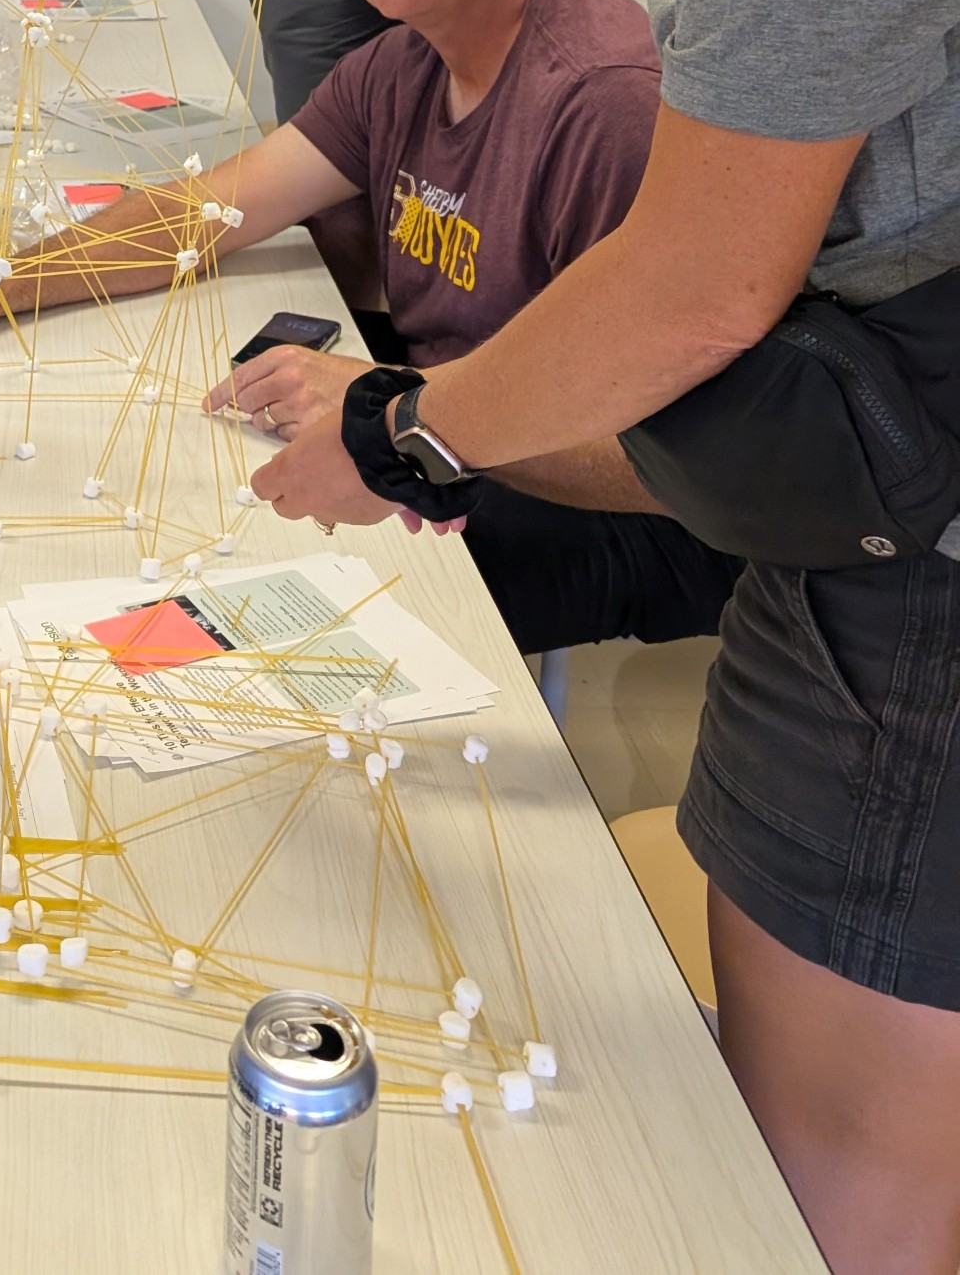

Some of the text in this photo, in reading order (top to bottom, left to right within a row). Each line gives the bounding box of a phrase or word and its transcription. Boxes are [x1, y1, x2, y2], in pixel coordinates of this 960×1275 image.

[116, 682, 145, 713] Effecve
[164, 740, 178, 750] 10
[263, 1144, 272, 1187] REFRESH
[272, 1120, 284, 1192] RECYCLE
